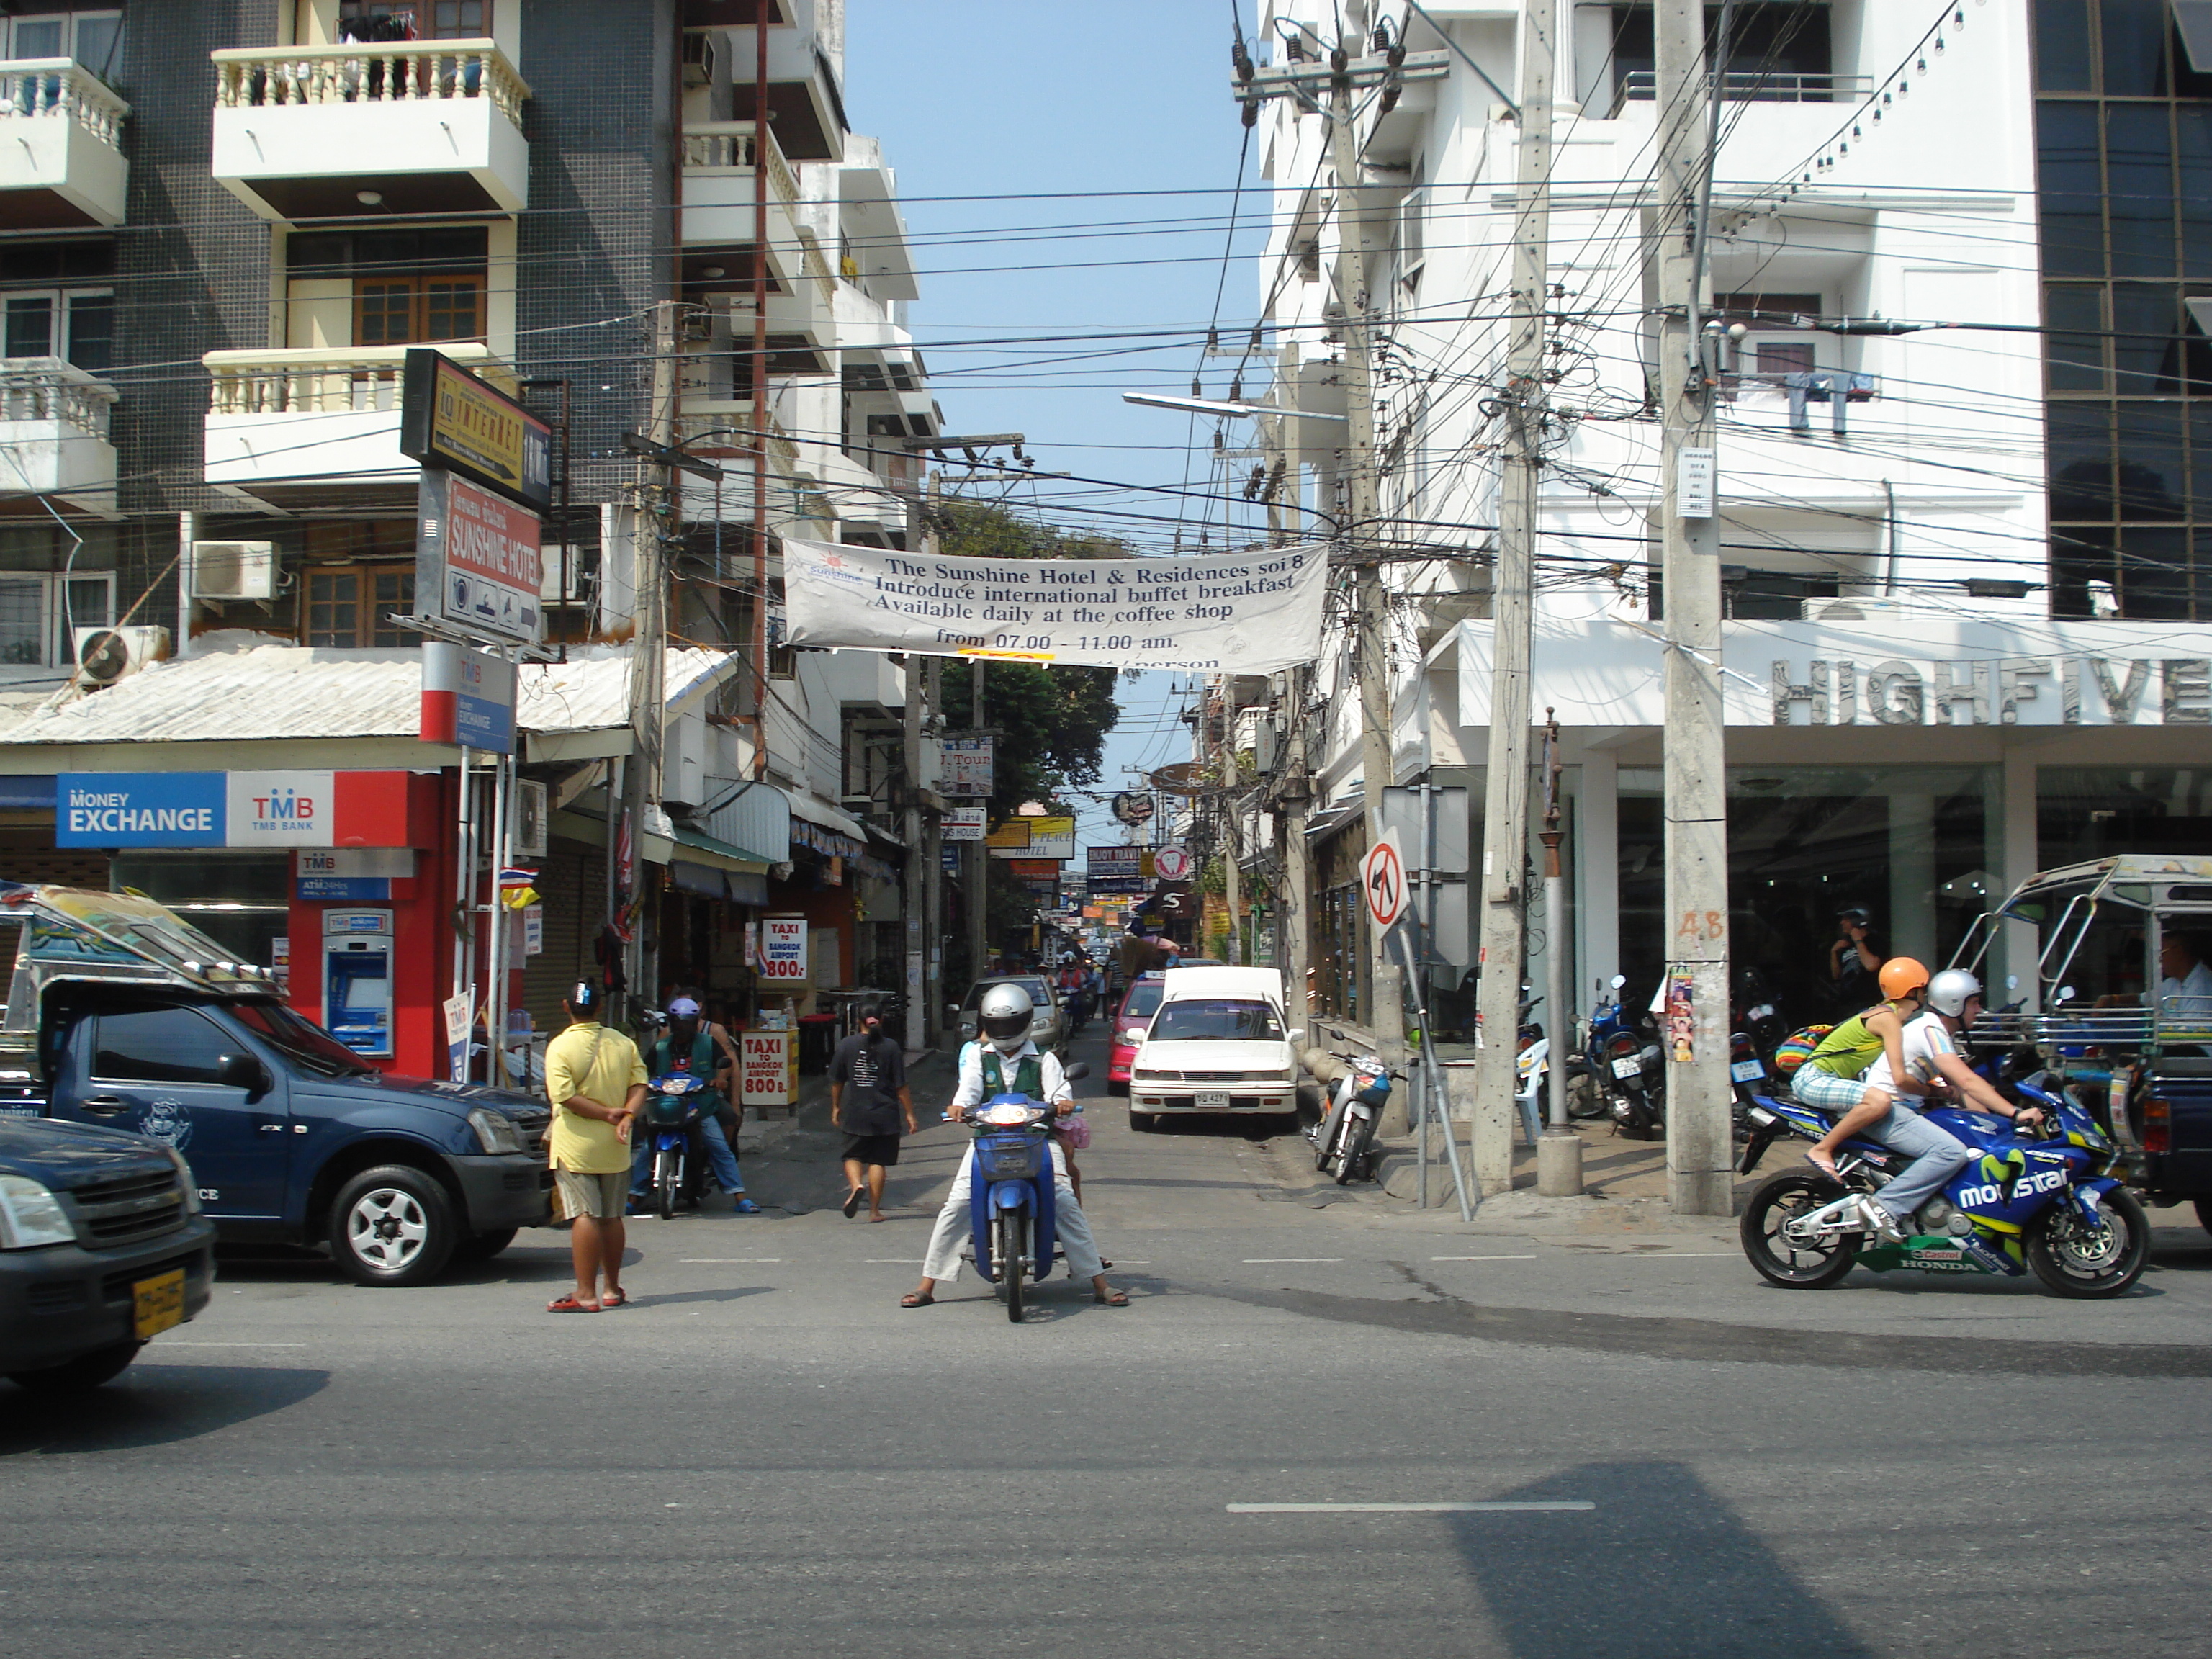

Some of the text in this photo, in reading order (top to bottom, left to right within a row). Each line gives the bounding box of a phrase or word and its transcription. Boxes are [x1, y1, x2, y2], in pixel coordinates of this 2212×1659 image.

[457, 400, 520, 454] INTERNET
[451, 514, 539, 588] SUNSHINE HOTEL
[810, 565, 862, 583] Sunshine
[885, 554, 1304, 585] The Sunshine Hotel & Residences soi 8
[875, 576, 976, 600] Introduce
[984, 585, 1118, 603] international
[1128, 587, 1189, 603] buffet
[1198, 575, 1295, 599] breakfast
[874, 594, 1233, 625] Available daily at the coffee shop
[937, 629, 986, 647] from
[995, 634, 1051, 649] 07.00
[1079, 635, 1133, 651] 11.00
[1141, 636, 1179, 649] am.
[460, 655, 482, 684] TMB
[1772, 658, 2211, 725] HIGHFIVE
[953, 754, 992, 765] Tour
[69, 789, 130, 808] MONEY
[252, 788, 314, 819] TMB
[69, 808, 213, 832] EXCHANGE
[252, 822, 313, 831] TMB BANK
[956, 827, 980, 837] HOUSE
[1040, 832, 1072, 842] PLACE
[1015, 846, 1048, 856] HOTEL
[303, 853, 335, 869] TMB
[771, 924, 799, 934] TAXI
[745, 1038, 781, 1054] TAXI
[1788, 1120, 1826, 1141] movista
[1923, 1250, 1959, 1259] Castrol
[1900, 1259, 1980, 1272] HONDA
